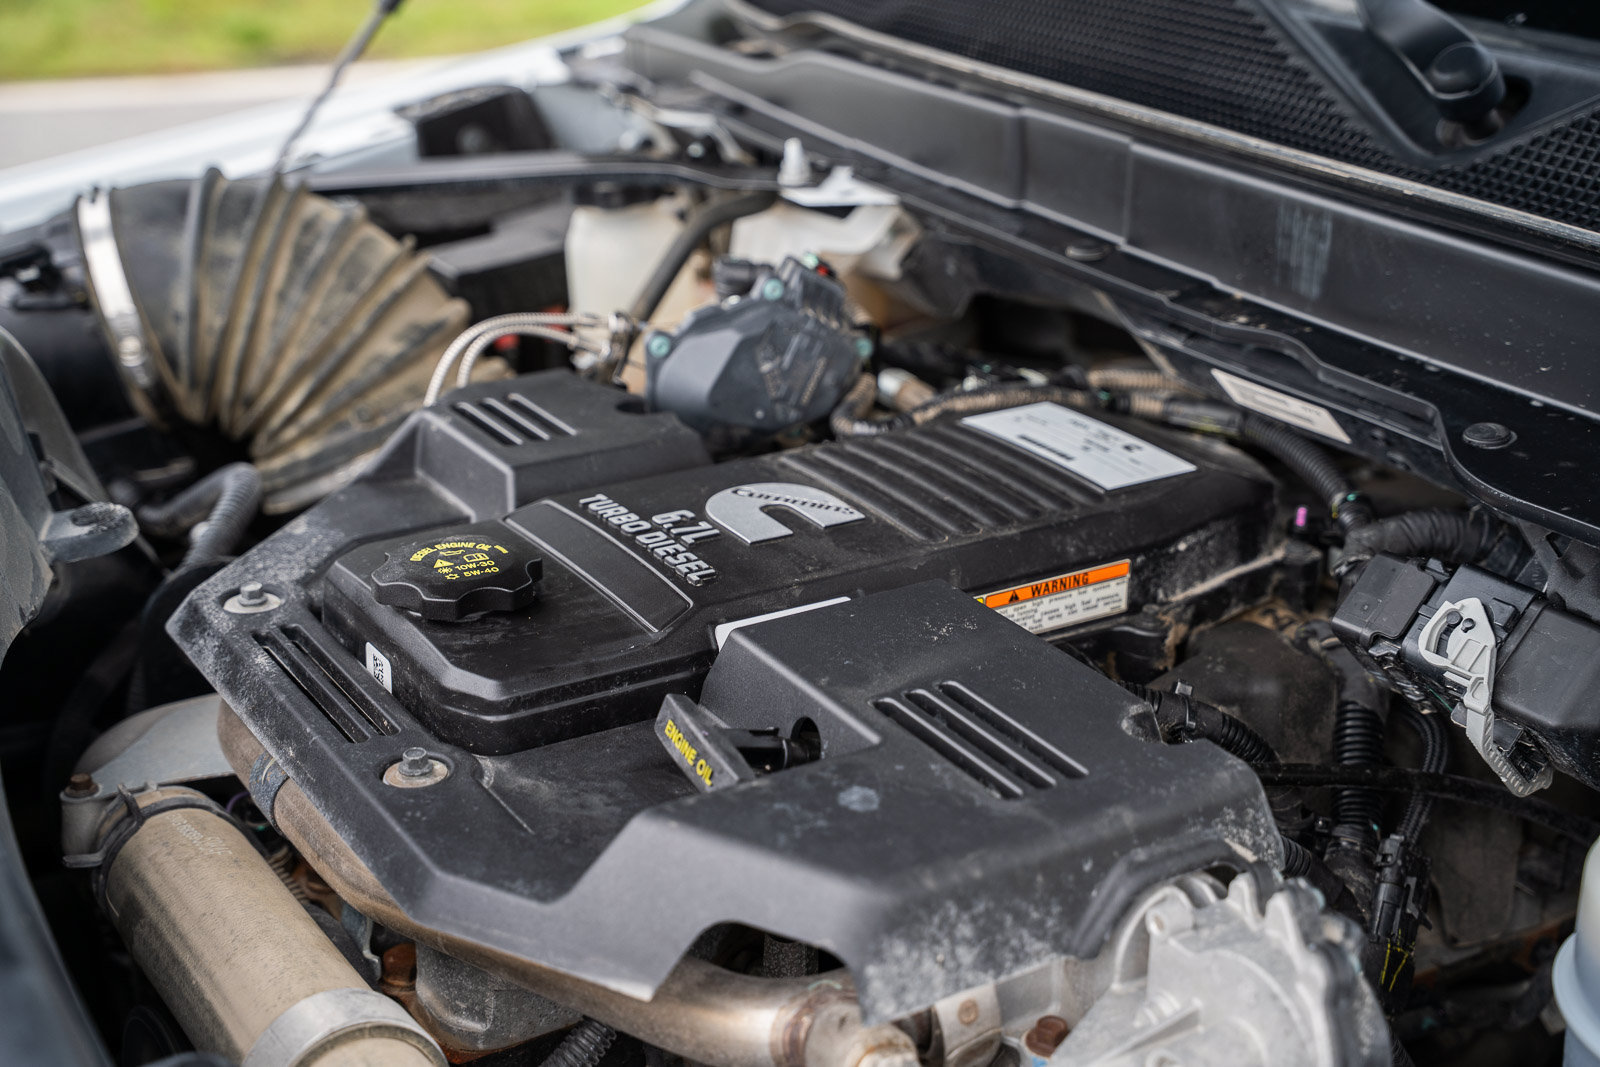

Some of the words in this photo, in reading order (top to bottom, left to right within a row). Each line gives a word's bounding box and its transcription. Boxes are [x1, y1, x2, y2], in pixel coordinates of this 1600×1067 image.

[731, 487, 855, 515] Cummins
[579, 493, 652, 536] TURBO
[636, 531, 717, 586] DIESEL
[652, 509, 720, 546] 6.7L
[434, 541, 476, 550] ENGINE
[455, 560, 495, 571] 10W-30
[463, 566, 499, 577] 5W-40
[1031, 572, 1089, 597] WARNING
[664, 719, 698, 767] ENGINE
[696, 759, 713, 786] OIL
